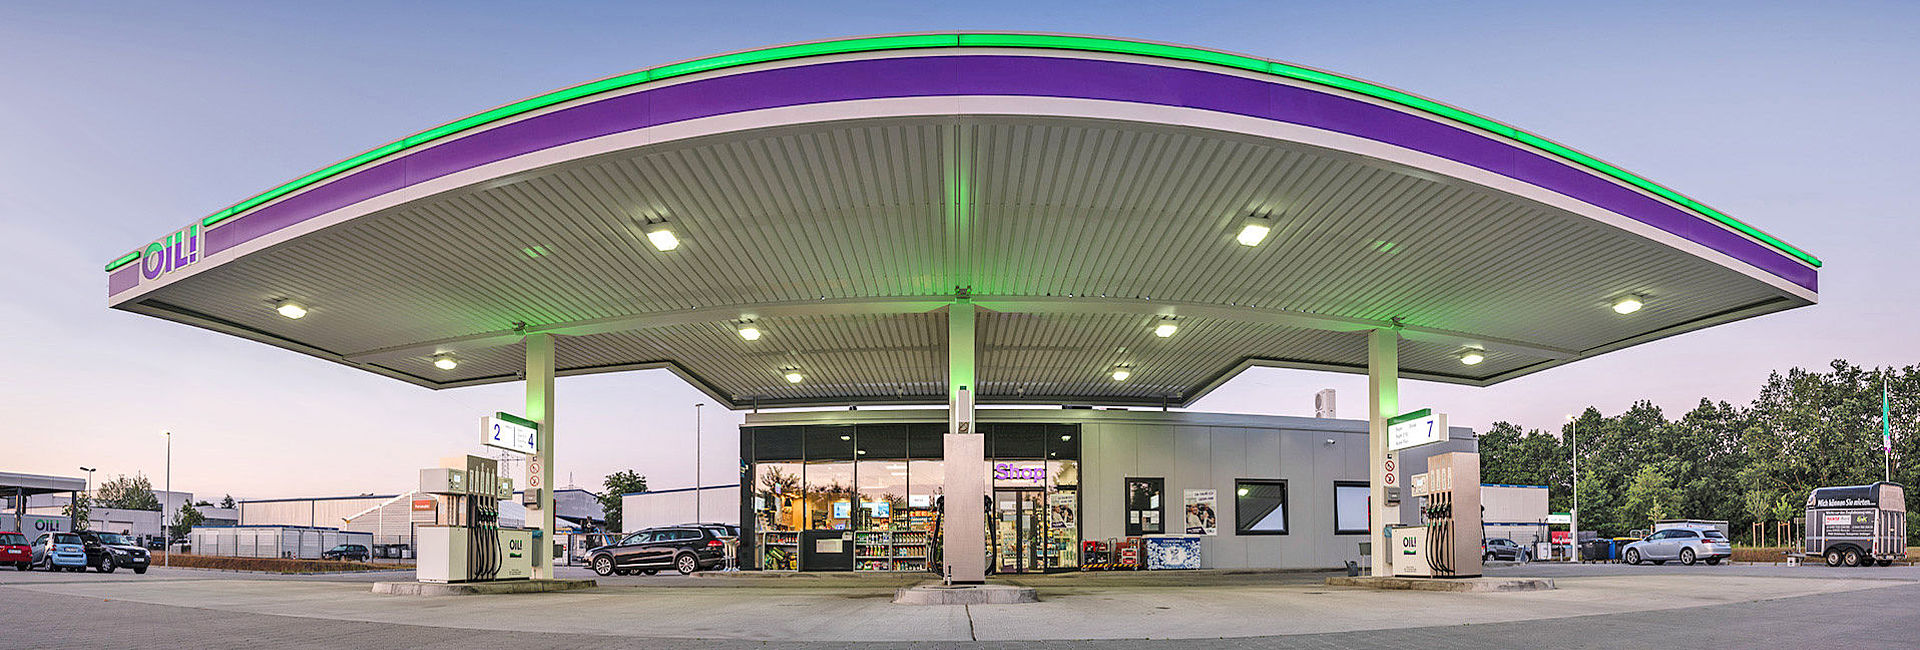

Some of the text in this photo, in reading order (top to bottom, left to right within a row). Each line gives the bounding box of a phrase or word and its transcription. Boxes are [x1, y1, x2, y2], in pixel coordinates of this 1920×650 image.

[142, 224, 198, 280] OIL!
[494, 424, 500, 440] 2
[1427, 420, 1433, 437] 7
[528, 433, 534, 449] 4
[996, 463, 1044, 483] Shop
[1846, 498, 1854, 506] Sie
[35, 519, 59, 531] OIL!
[509, 539, 522, 550] OIL!
[1403, 536, 1416, 547] OIL!
